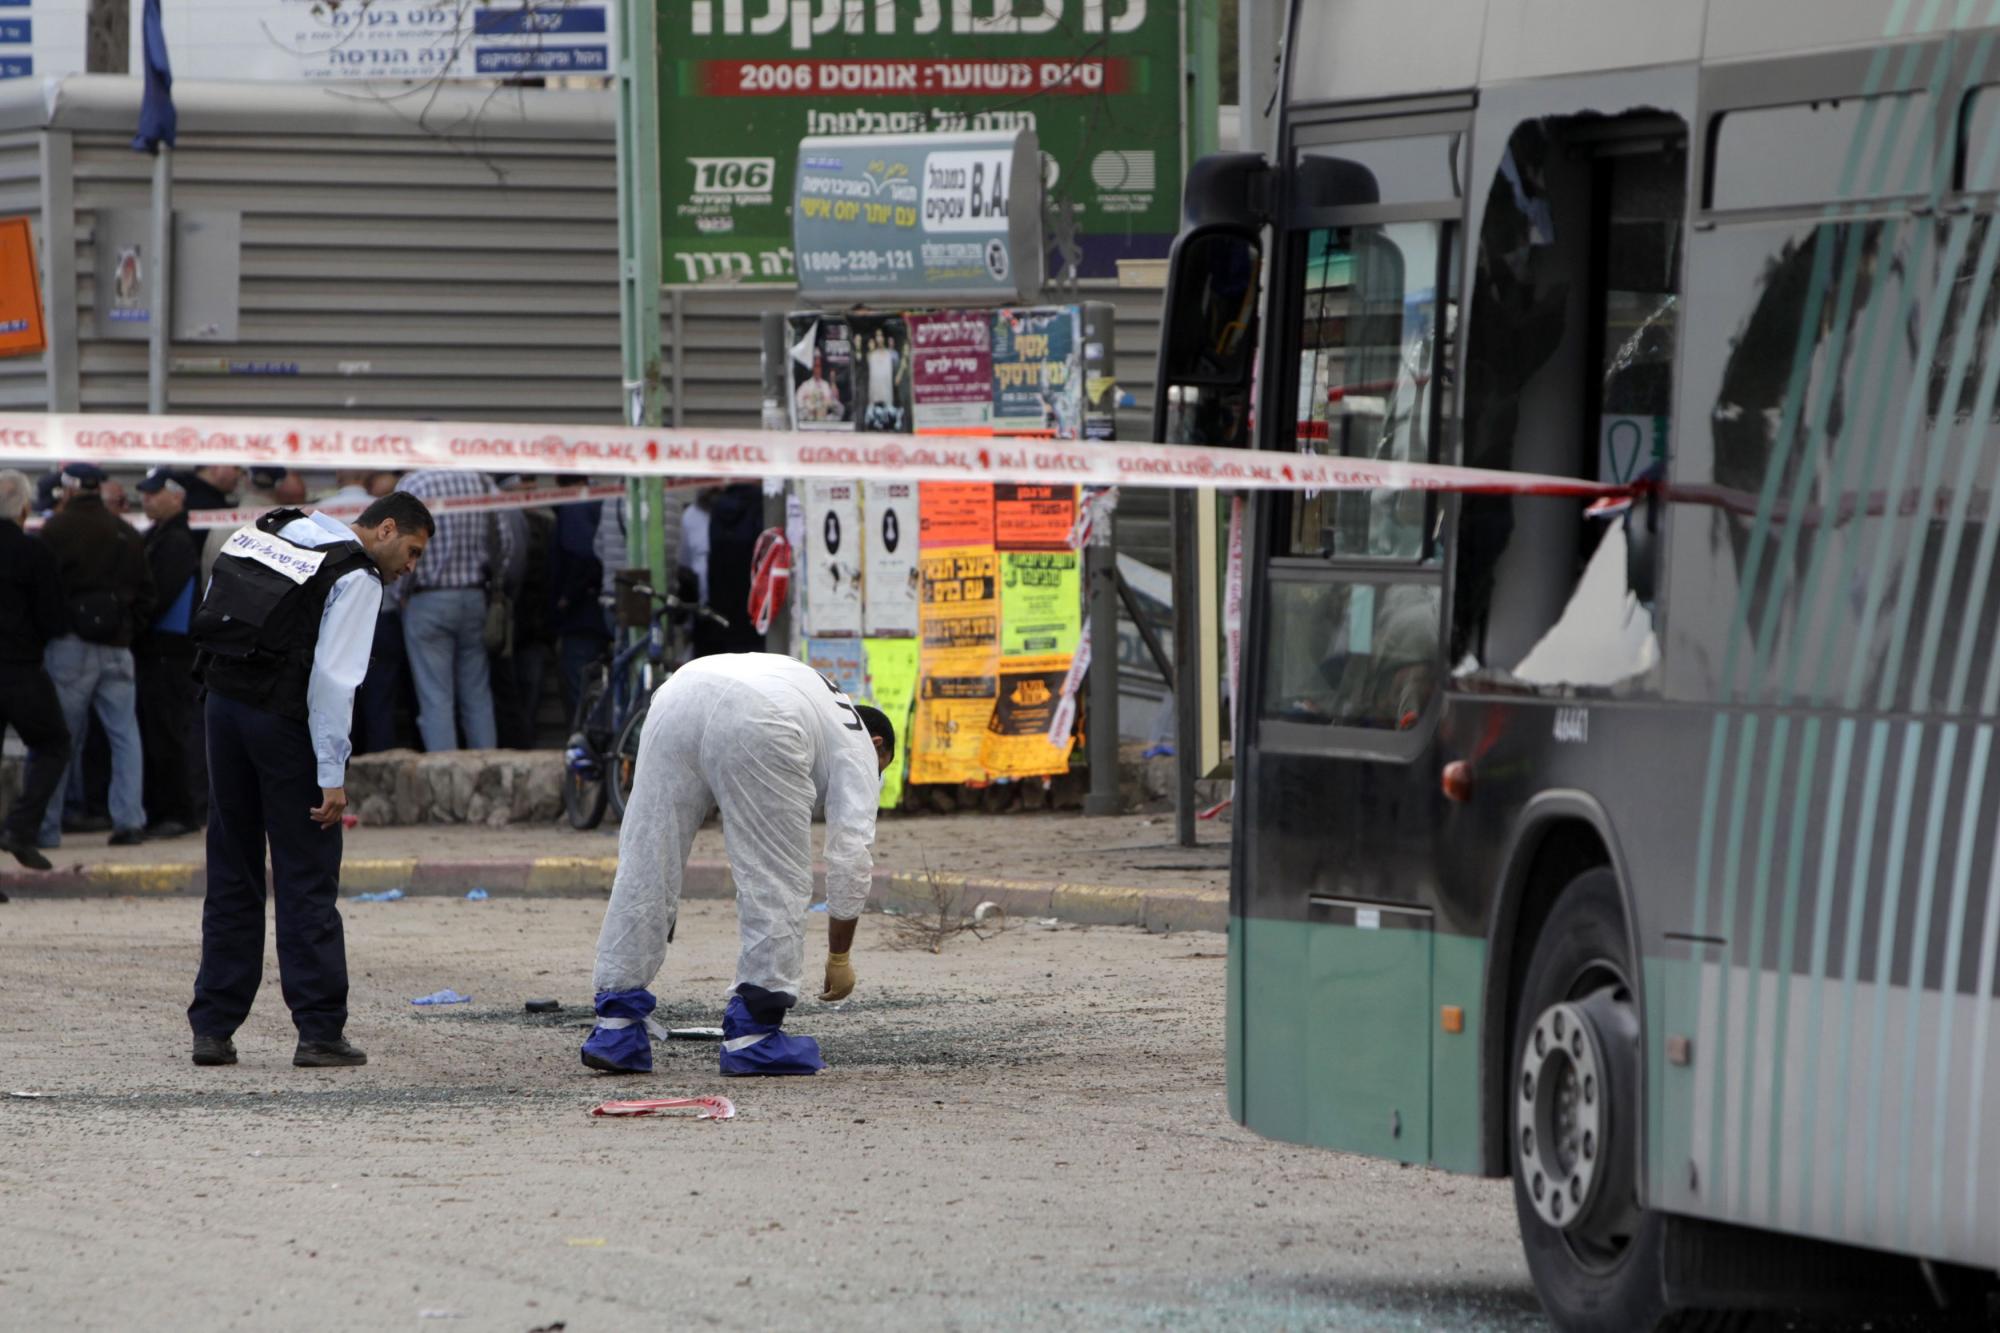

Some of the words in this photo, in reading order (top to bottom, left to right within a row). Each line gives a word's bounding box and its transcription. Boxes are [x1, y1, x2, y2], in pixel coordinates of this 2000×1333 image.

[739, 64, 812, 90] 2006
[819, 63, 918, 89] אוגוסט
[924, 63, 1033, 88] משוער:
[1040, 63, 1104, 88] סיום
[701, 162, 769, 188] 106
[673, 251, 755, 282] בדרך
[801, 250, 914, 271] 1800-220-121
